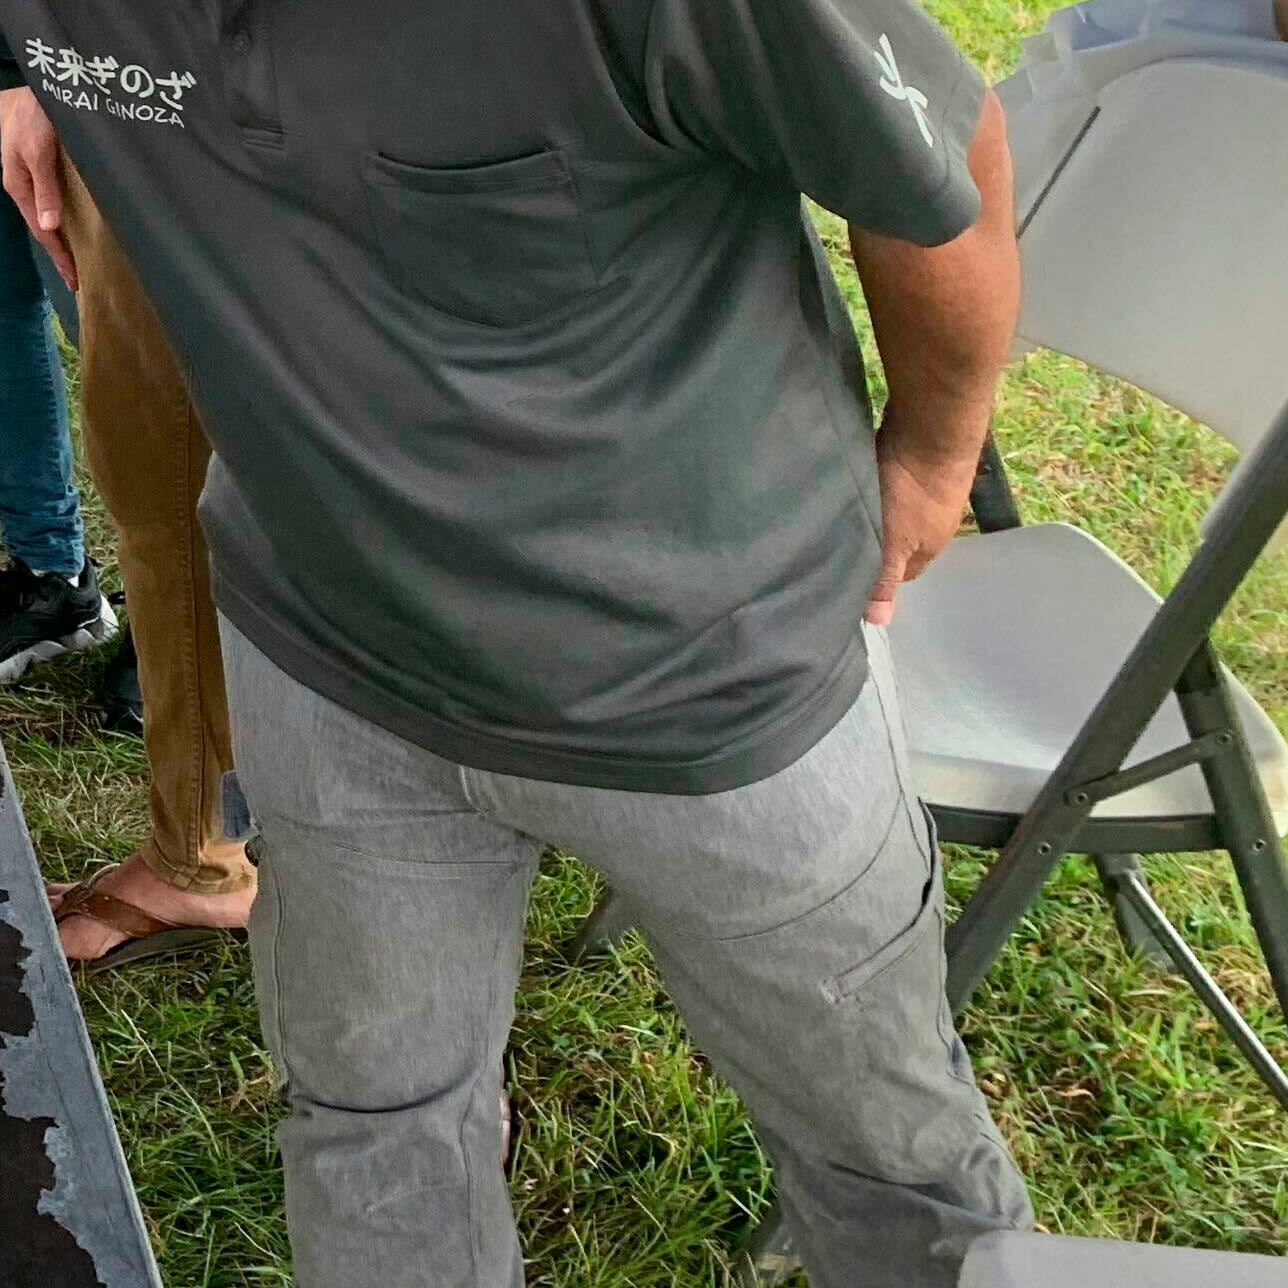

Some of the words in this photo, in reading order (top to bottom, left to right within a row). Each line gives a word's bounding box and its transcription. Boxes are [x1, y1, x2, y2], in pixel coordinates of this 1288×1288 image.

[25, 37, 198, 111] 未来ぎのざ
[41, 78, 99, 112] MIRAI
[105, 98, 185, 129] GINOZA
